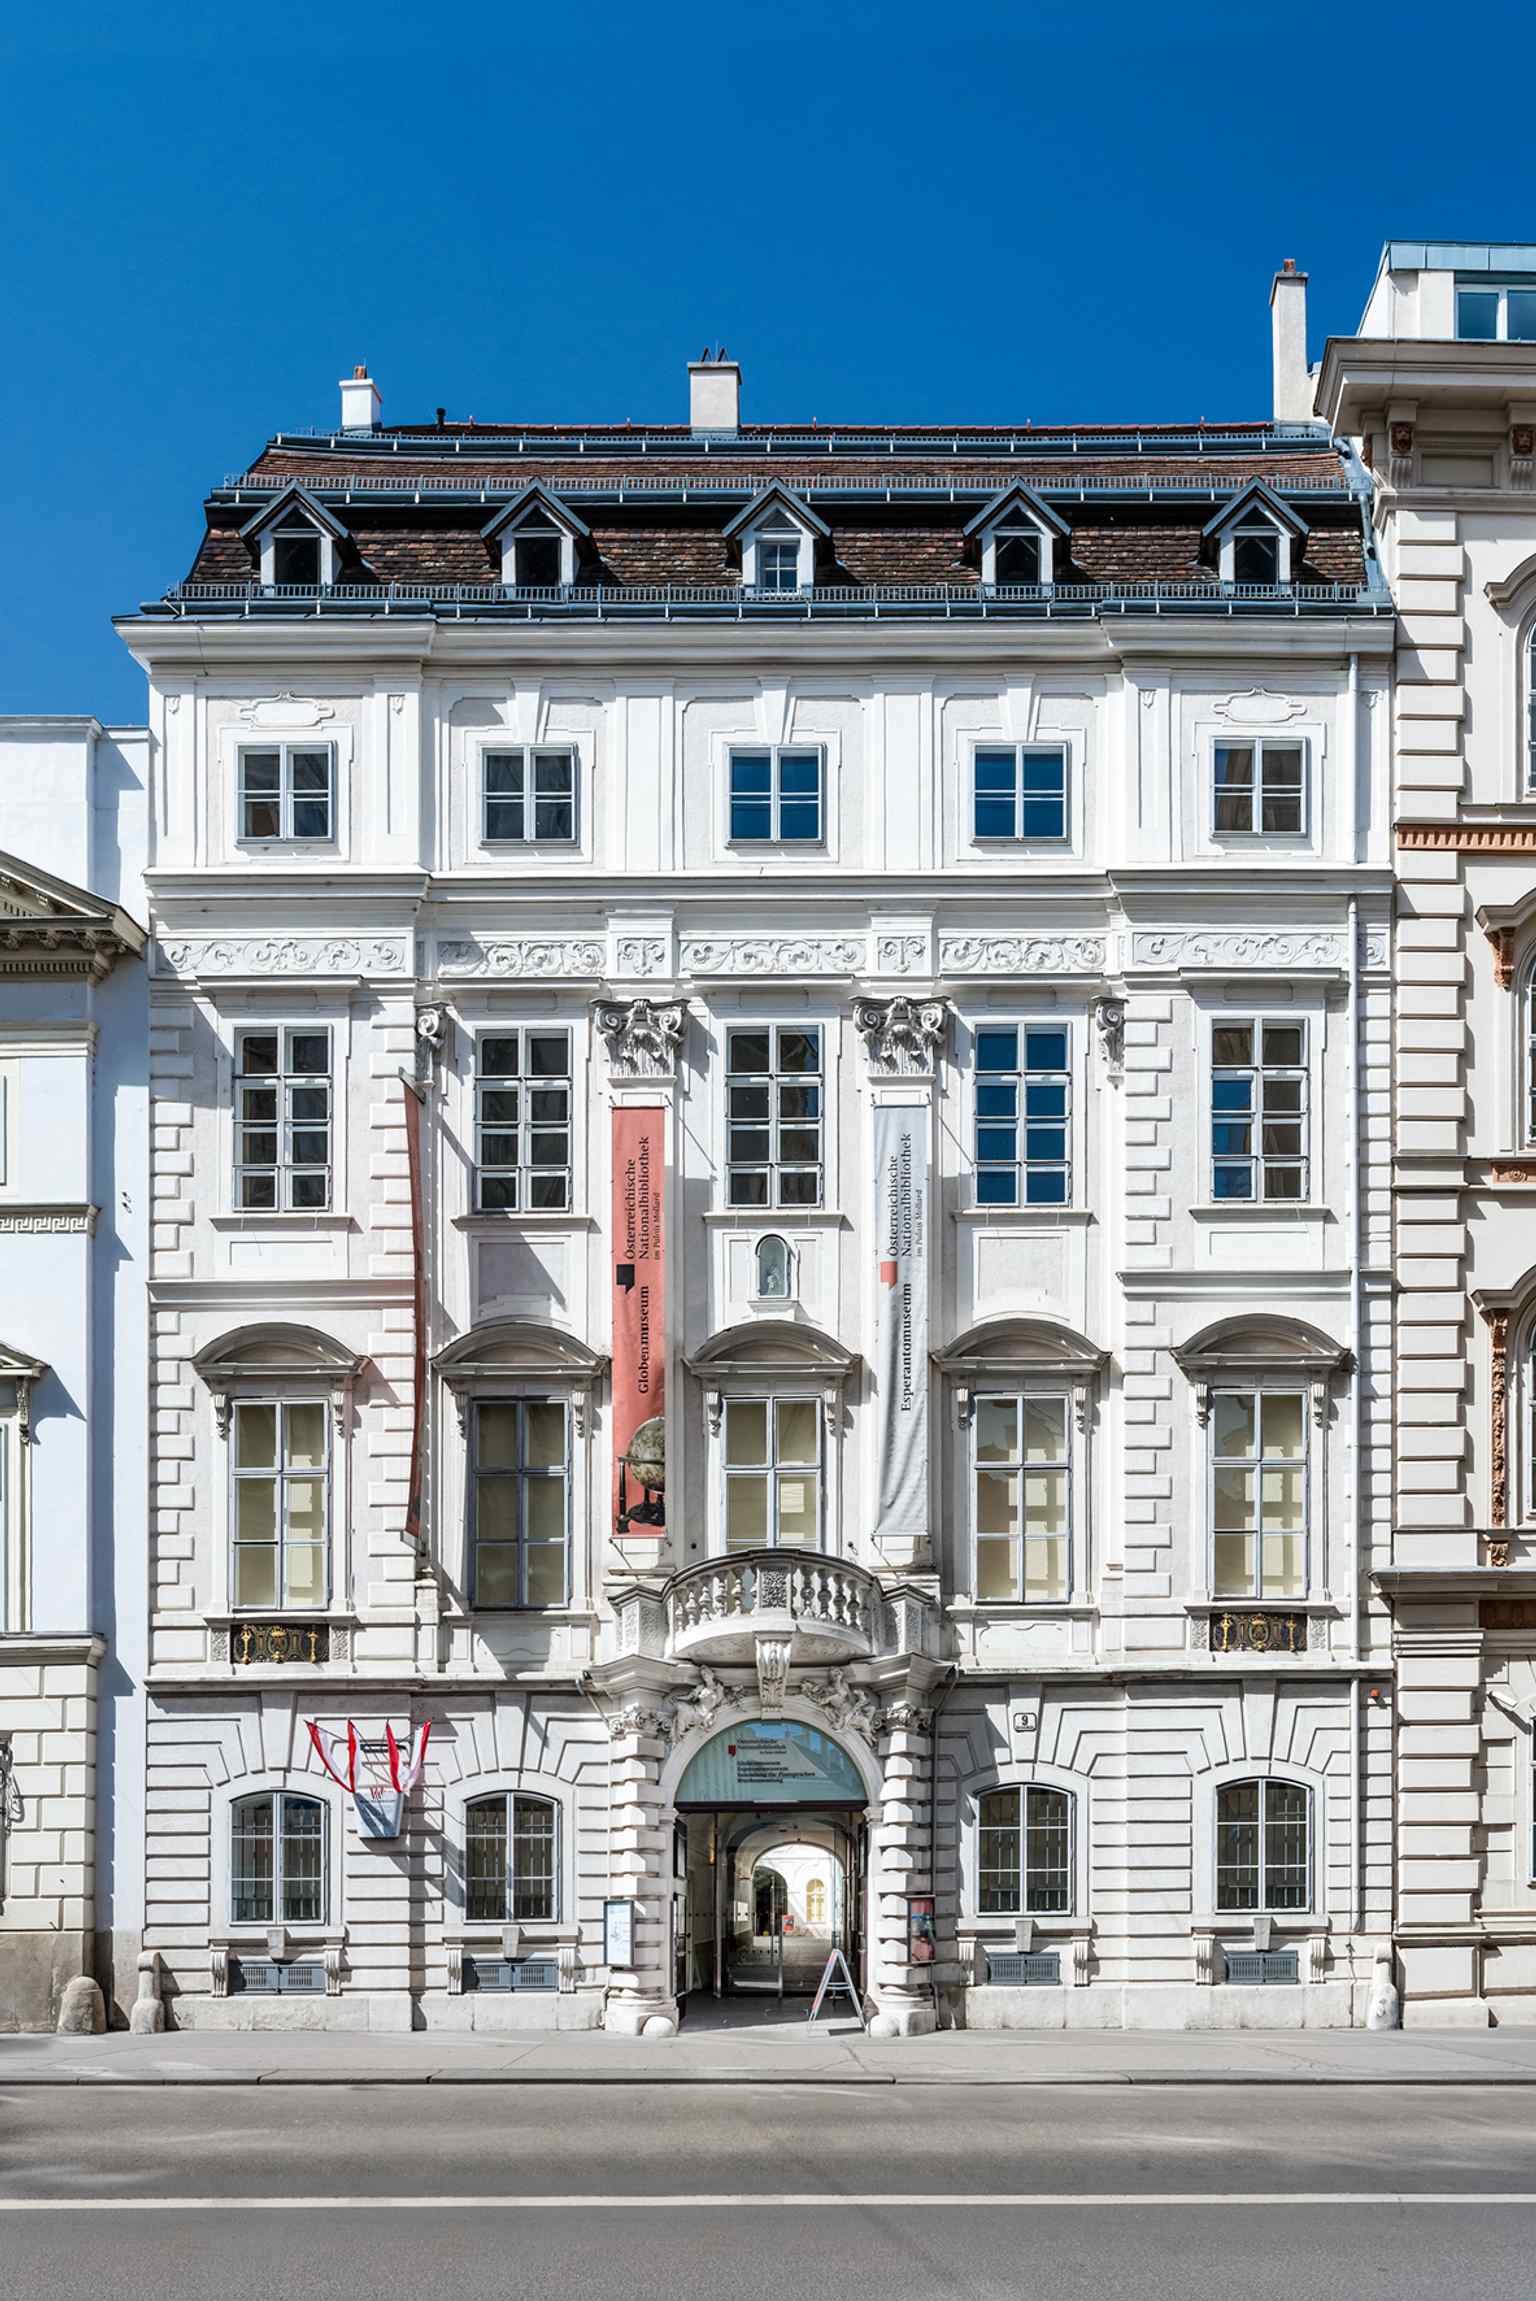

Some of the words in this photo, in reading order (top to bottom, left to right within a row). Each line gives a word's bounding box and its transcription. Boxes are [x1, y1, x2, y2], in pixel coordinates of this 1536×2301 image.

[625, 1159, 636, 1260] Österreichische
[638, 1136, 650, 1260] Nationalbibliothek
[887, 1155, 899, 1257] Österreichische
[901, 1132, 912, 1257] Nationalbibliothek
[638, 1286, 649, 1394] Globenmuseum
[901, 1283, 914, 1412] Esperantomuseum
[1021, 1715, 1029, 1726] 9
